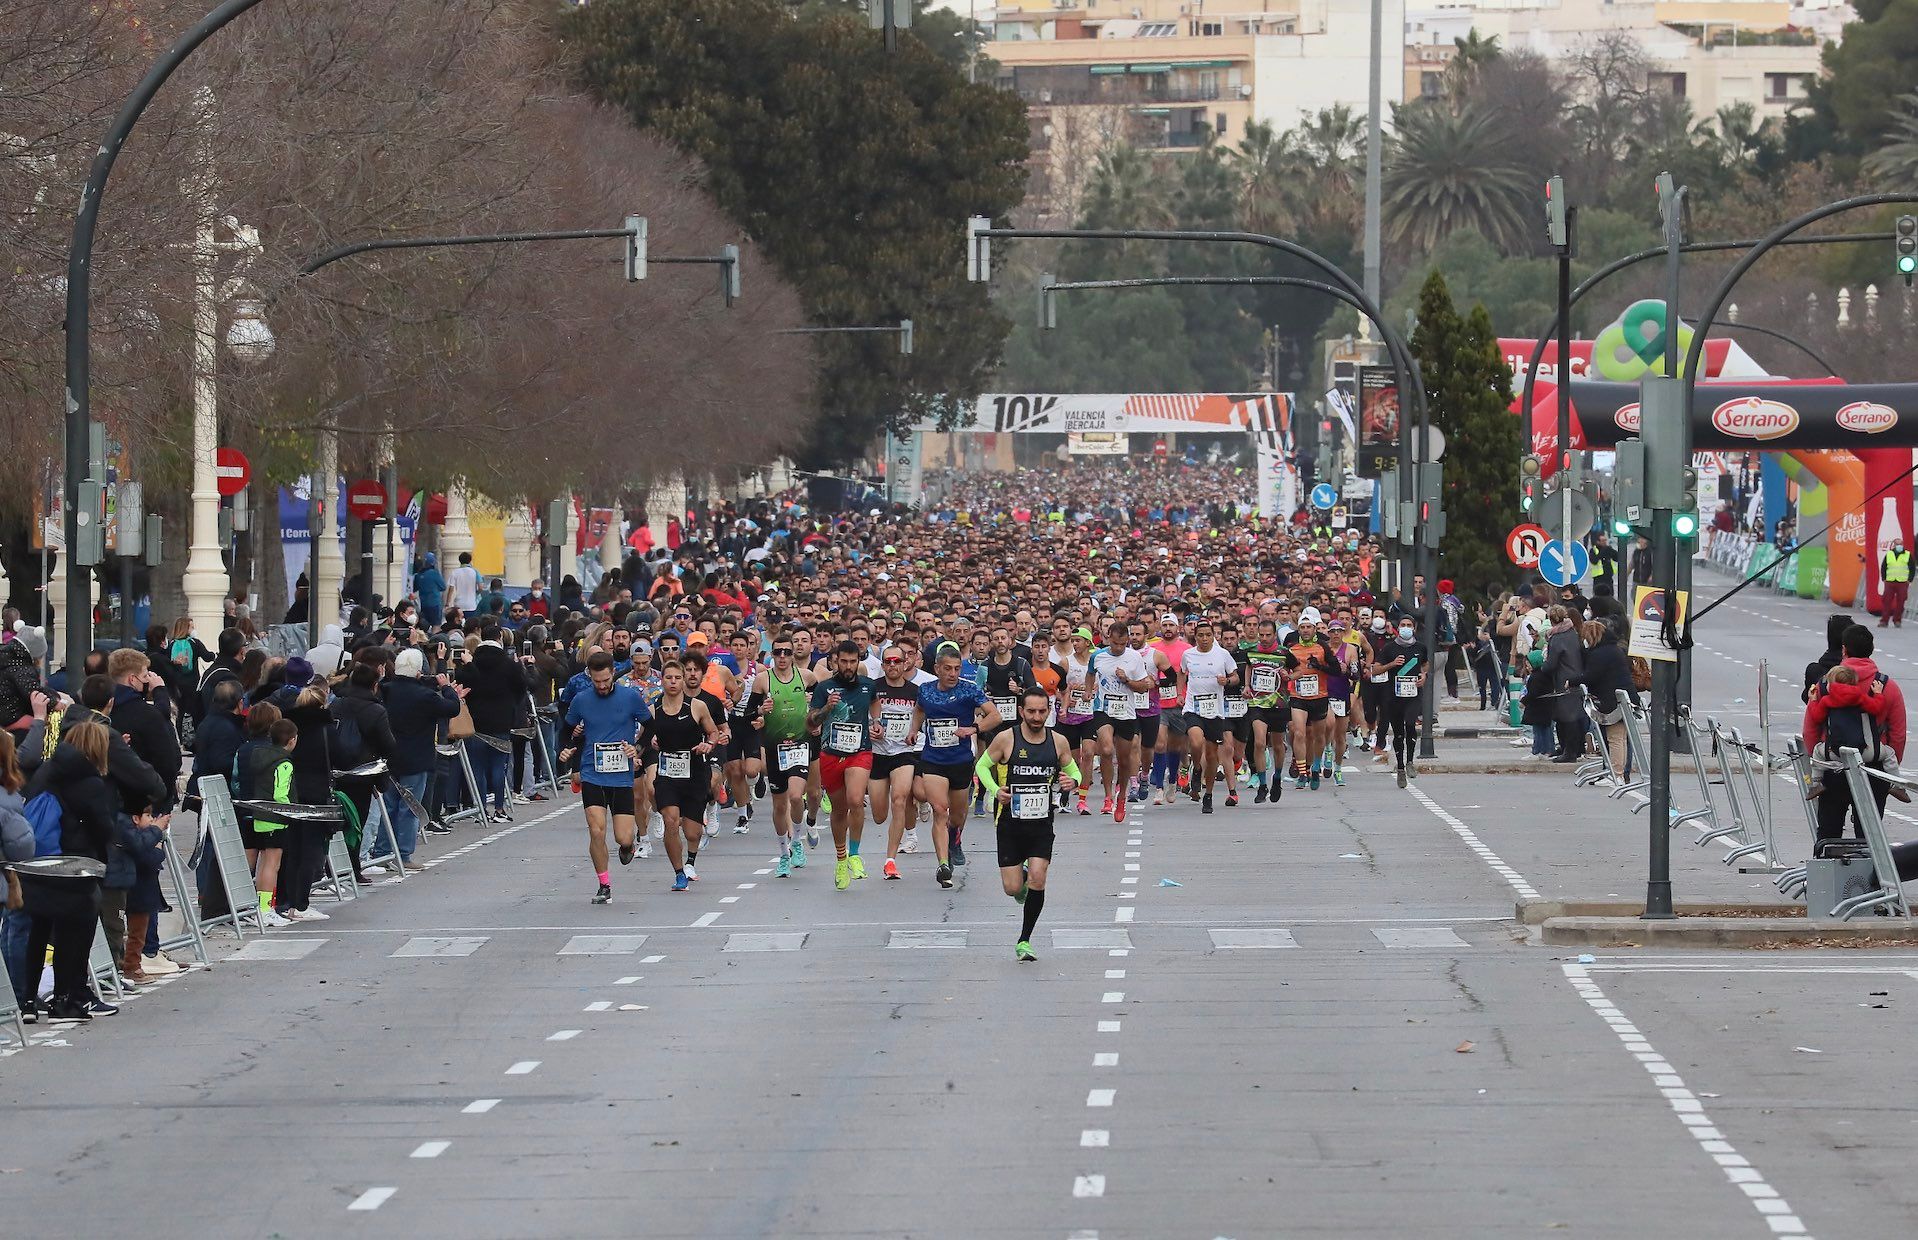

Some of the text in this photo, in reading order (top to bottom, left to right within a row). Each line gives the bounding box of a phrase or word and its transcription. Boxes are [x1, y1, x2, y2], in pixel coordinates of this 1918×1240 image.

[993, 396, 1058, 432] 10K
[1065, 411, 1106, 420] VALENCIA
[1722, 408, 1790, 428] Serrano
[1842, 408, 1892, 424] Serrano
[1064, 420, 1106, 430] IBERCAJA
[1024, 798, 1044, 808] 2717
